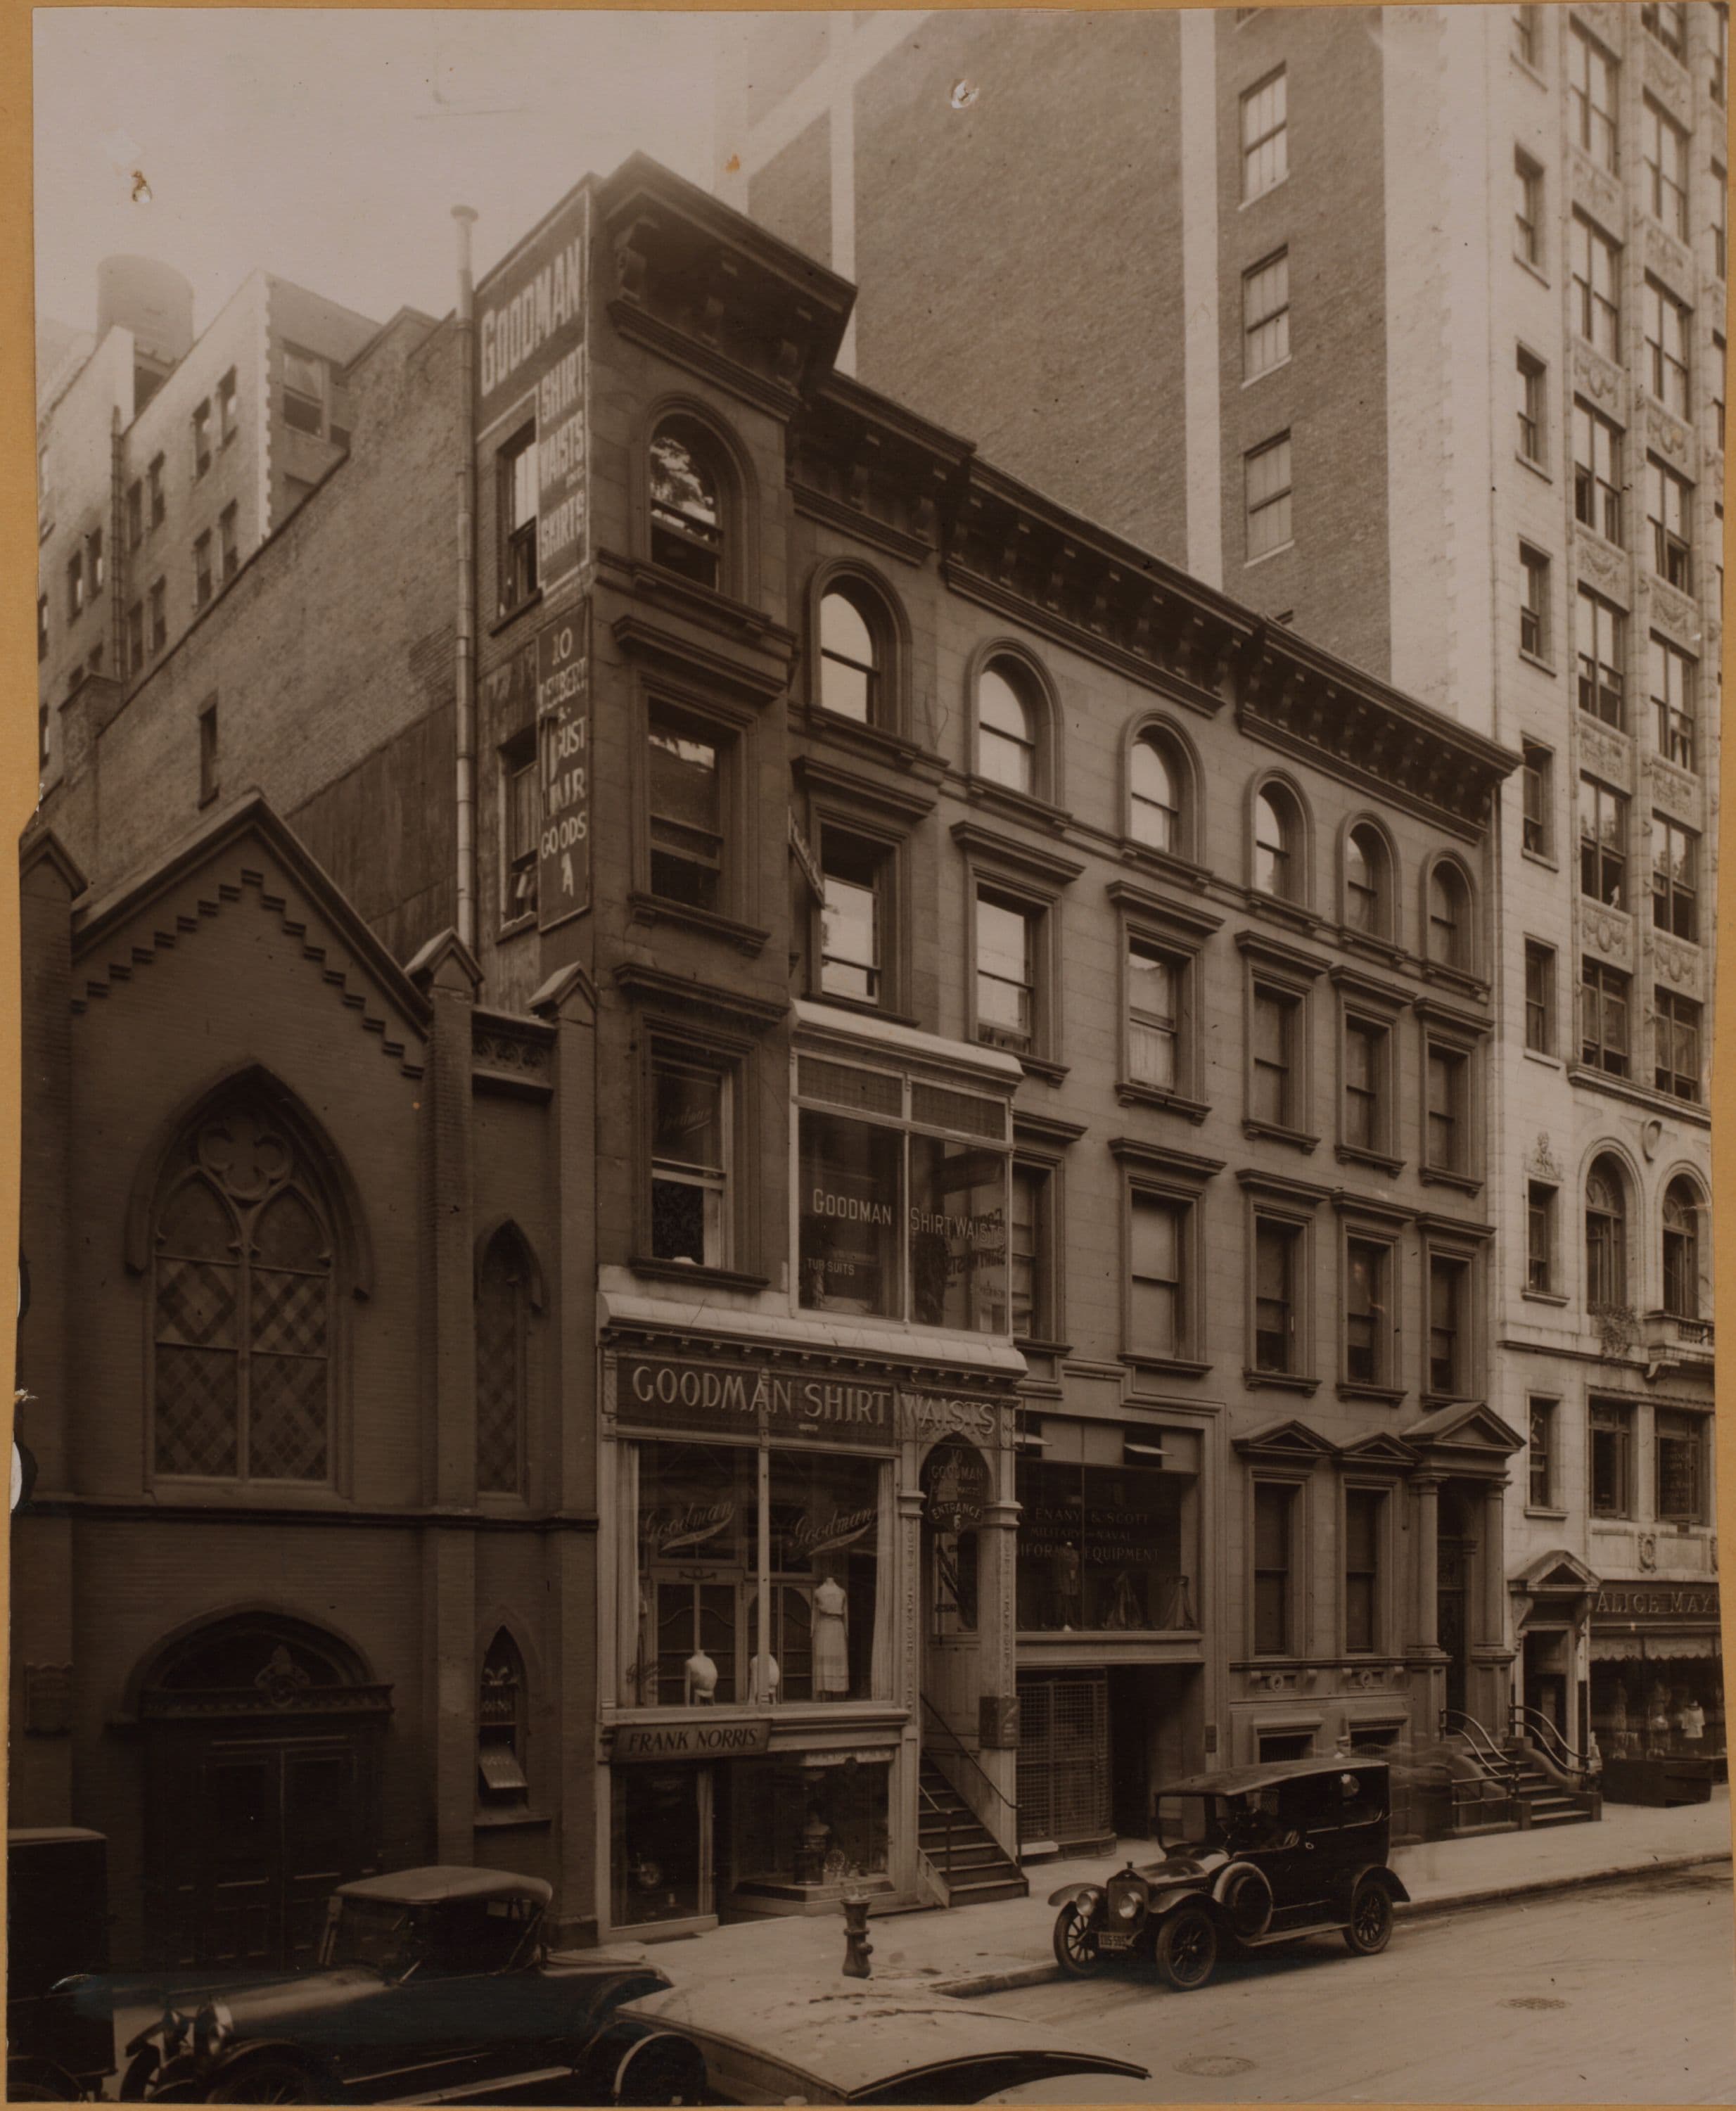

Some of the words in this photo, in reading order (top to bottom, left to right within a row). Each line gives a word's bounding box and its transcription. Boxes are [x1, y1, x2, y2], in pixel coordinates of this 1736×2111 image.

[481, 238, 581, 398] GOODMAN
[540, 342, 585, 423] SHIRT
[541, 812, 587, 860] GOODS
[812, 1187, 892, 1226] GOODMAN
[910, 1206, 952, 1238] SHIRT
[826, 1261, 855, 1276] SUITS
[634, 1366, 792, 1415] GOODMAN
[804, 1384, 891, 1425] SHIRT
[1084, 1546, 1160, 1564] EQUIPMENT
[1595, 1590, 1660, 1614] ALICE
[628, 1730, 689, 1752] FRANK
[696, 1728, 758, 1751] NORRIS
